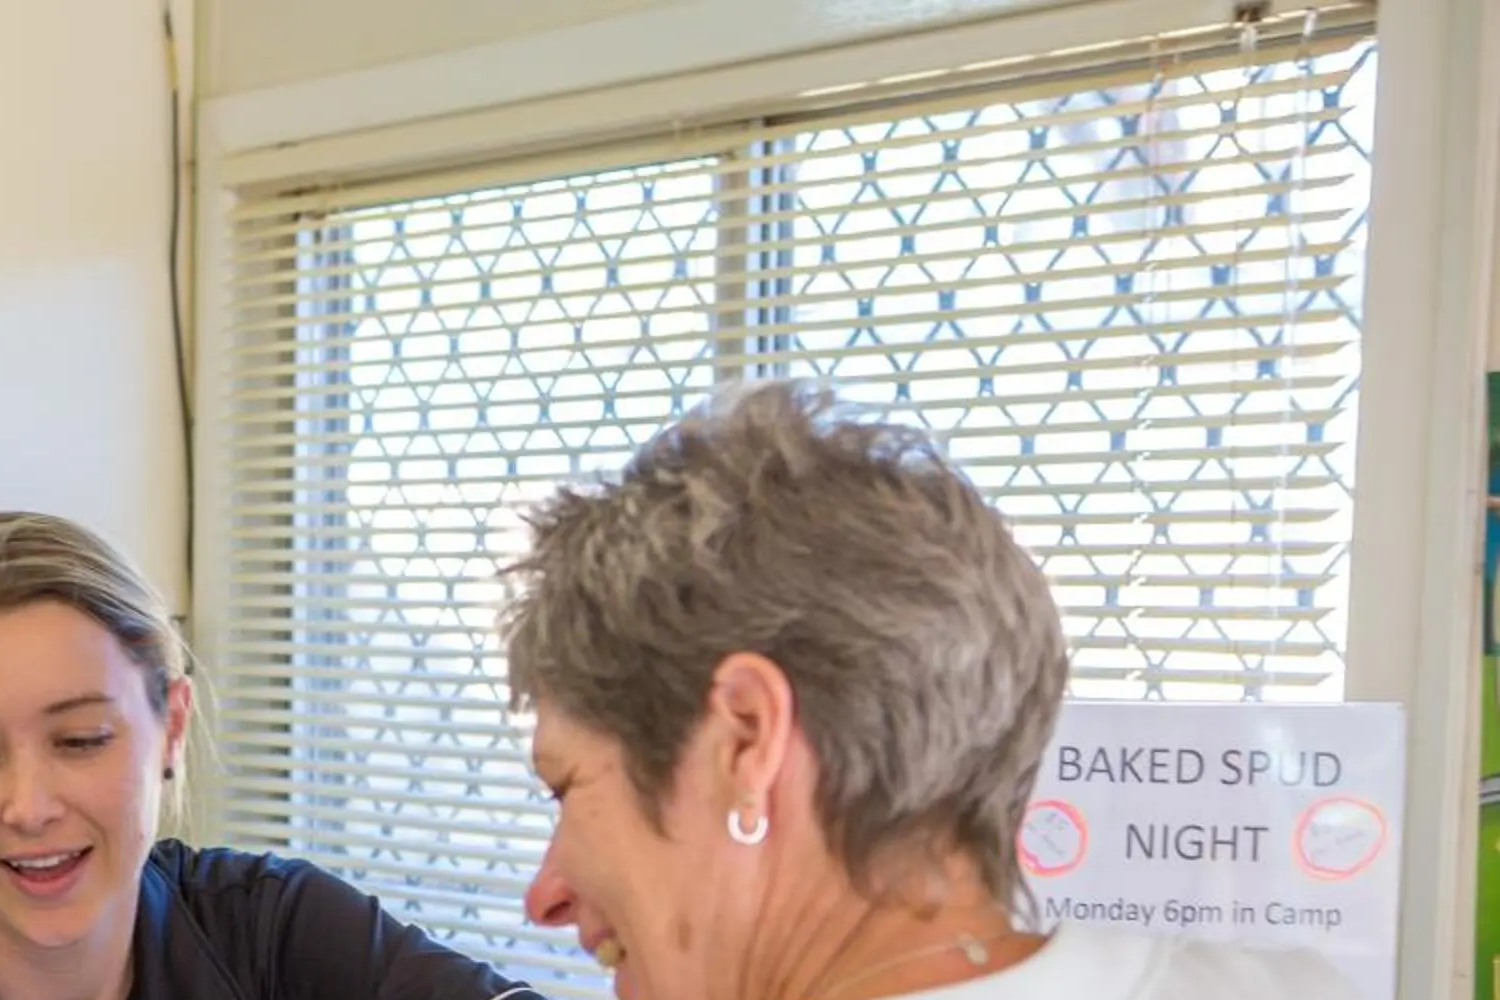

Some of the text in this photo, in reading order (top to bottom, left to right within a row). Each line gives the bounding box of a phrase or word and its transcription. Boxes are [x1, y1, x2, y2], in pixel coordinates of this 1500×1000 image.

[1057, 746, 1342, 787] BAKED SPUD
[1124, 823, 1269, 862] NIGHT
[1044, 896, 1342, 931] Monday 6pm in Camp
